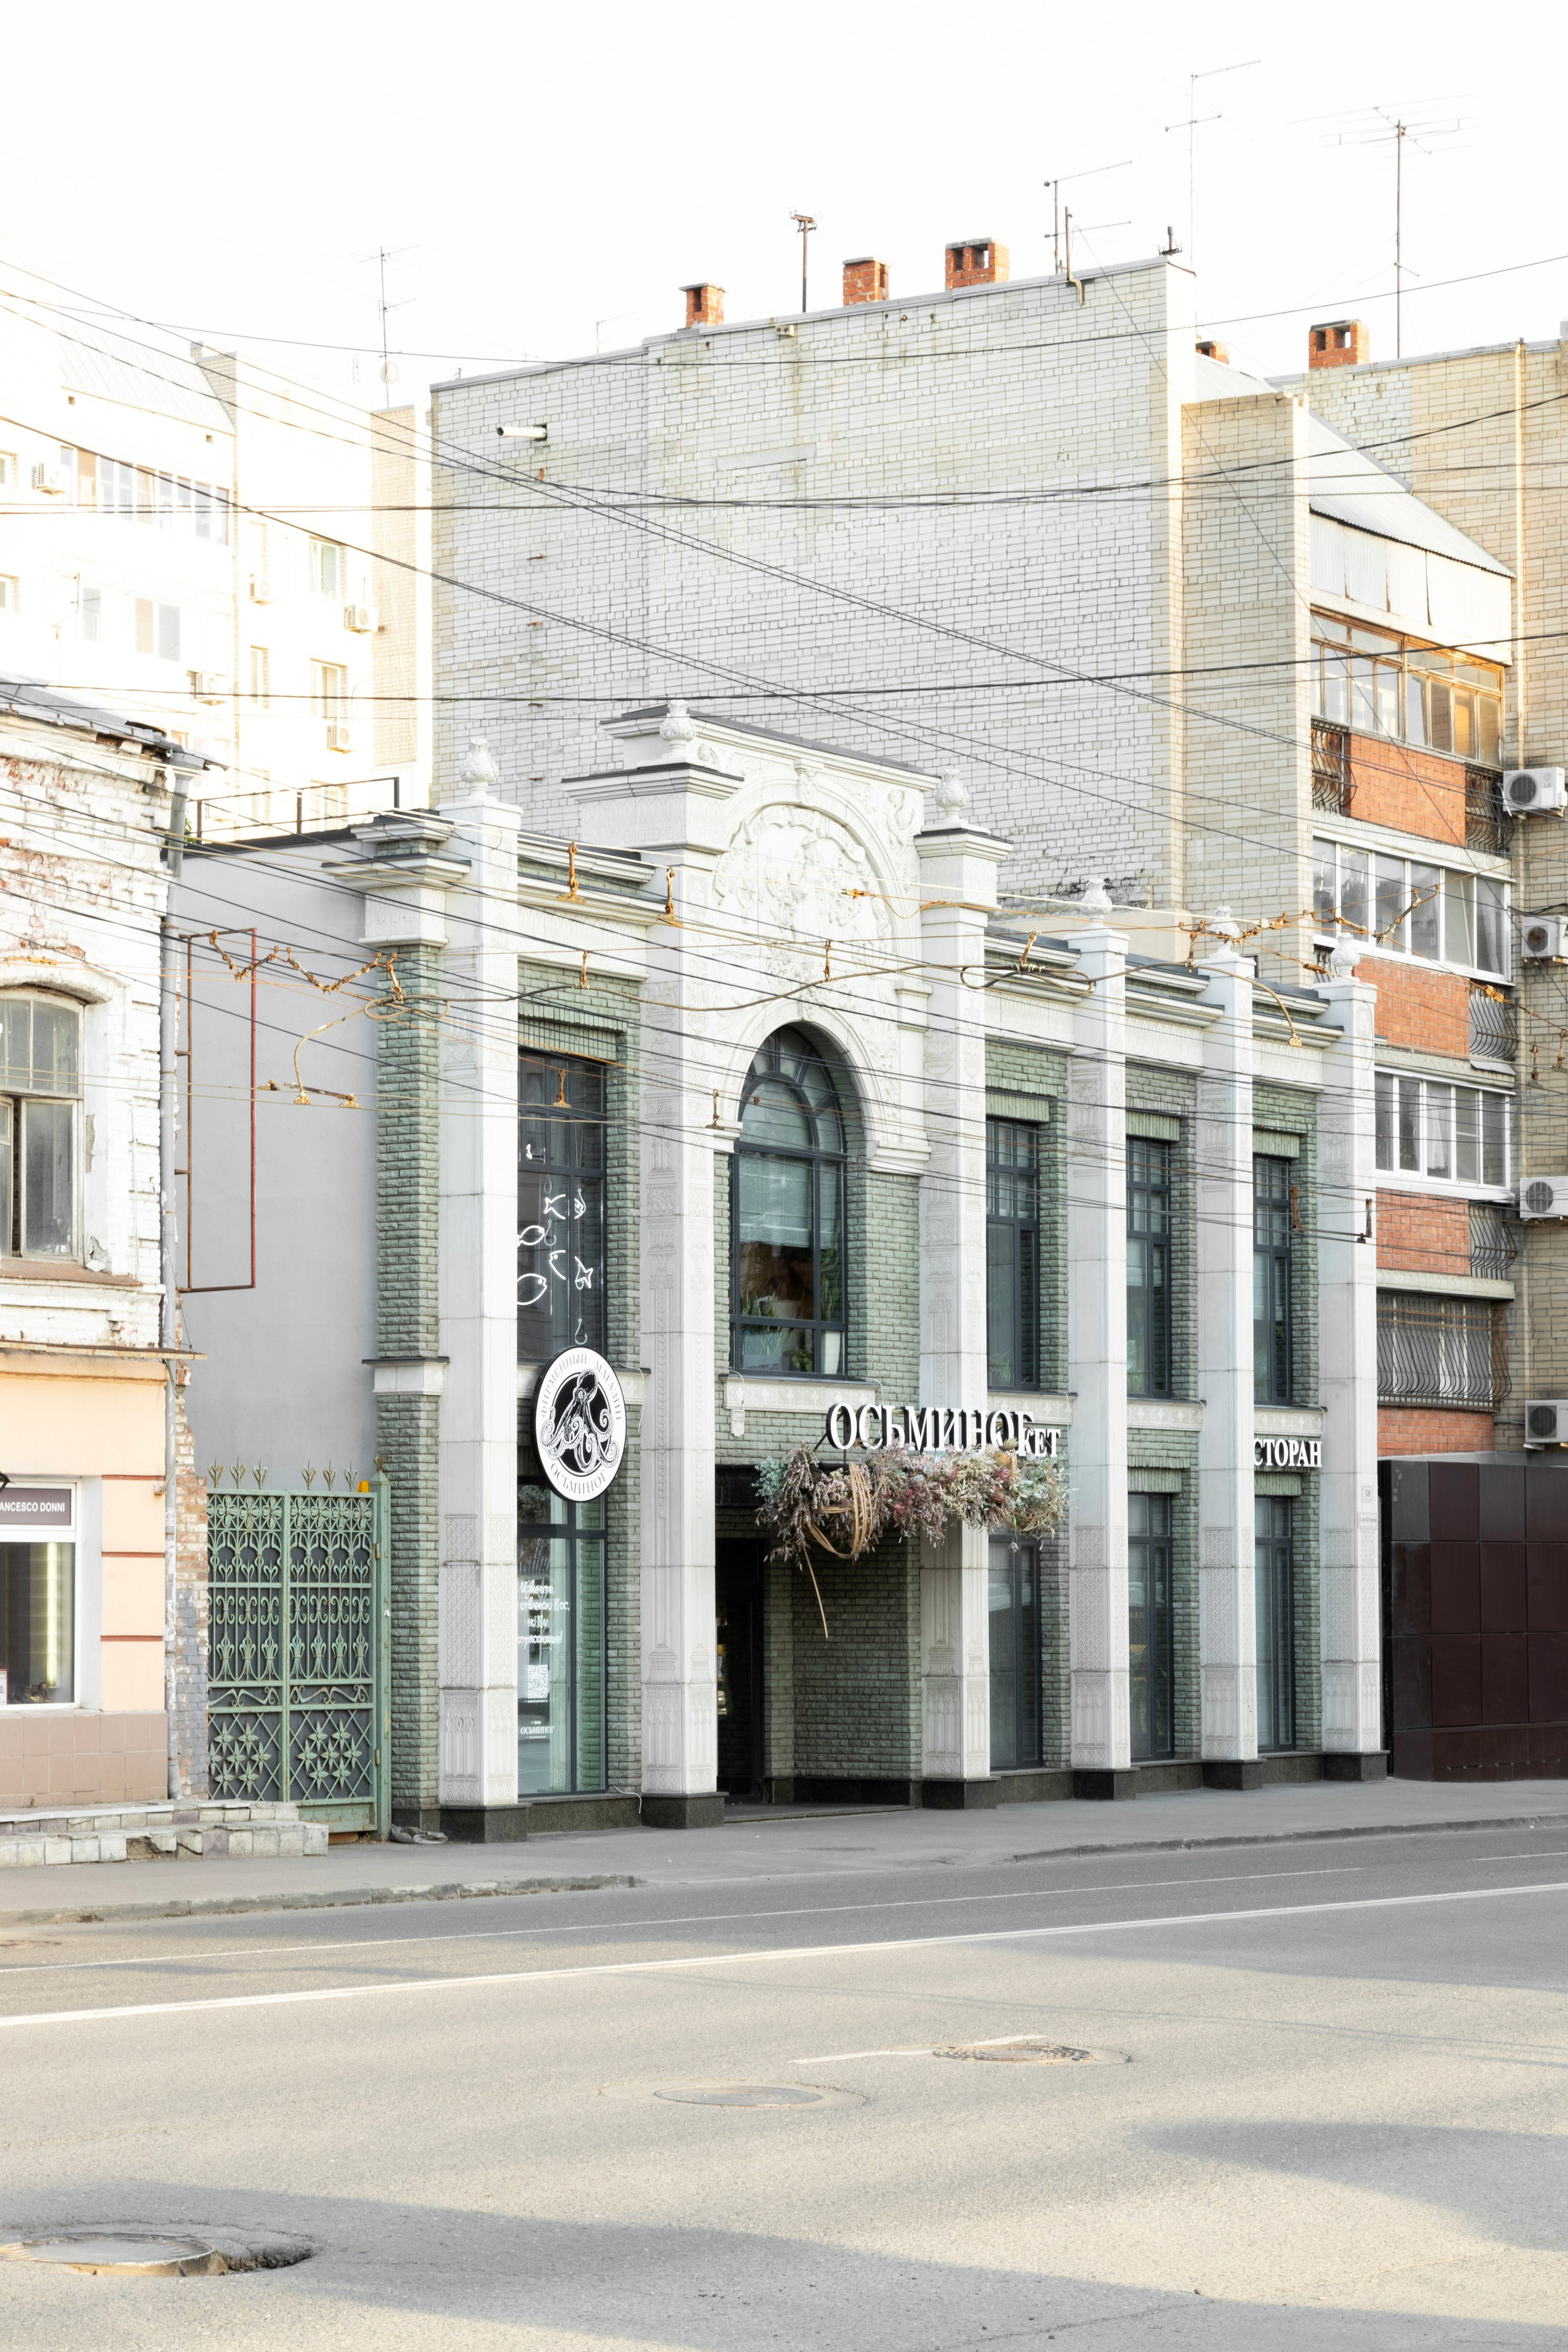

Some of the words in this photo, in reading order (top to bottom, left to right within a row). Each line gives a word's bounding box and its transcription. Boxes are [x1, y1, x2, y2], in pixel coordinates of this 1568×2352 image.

[541, 1352, 587, 1417] ФИРМЕННЫЙ
[594, 1361, 621, 1420] МАГАЗИН
[826, 1403, 1034, 1455] ОСЬМИНОГ
[551, 1463, 606, 1494] ОСЬМИНОГ
[40, 1502, 65, 1512] DONNI
[521, 1725, 555, 1735] ОСЬМИНОГ
